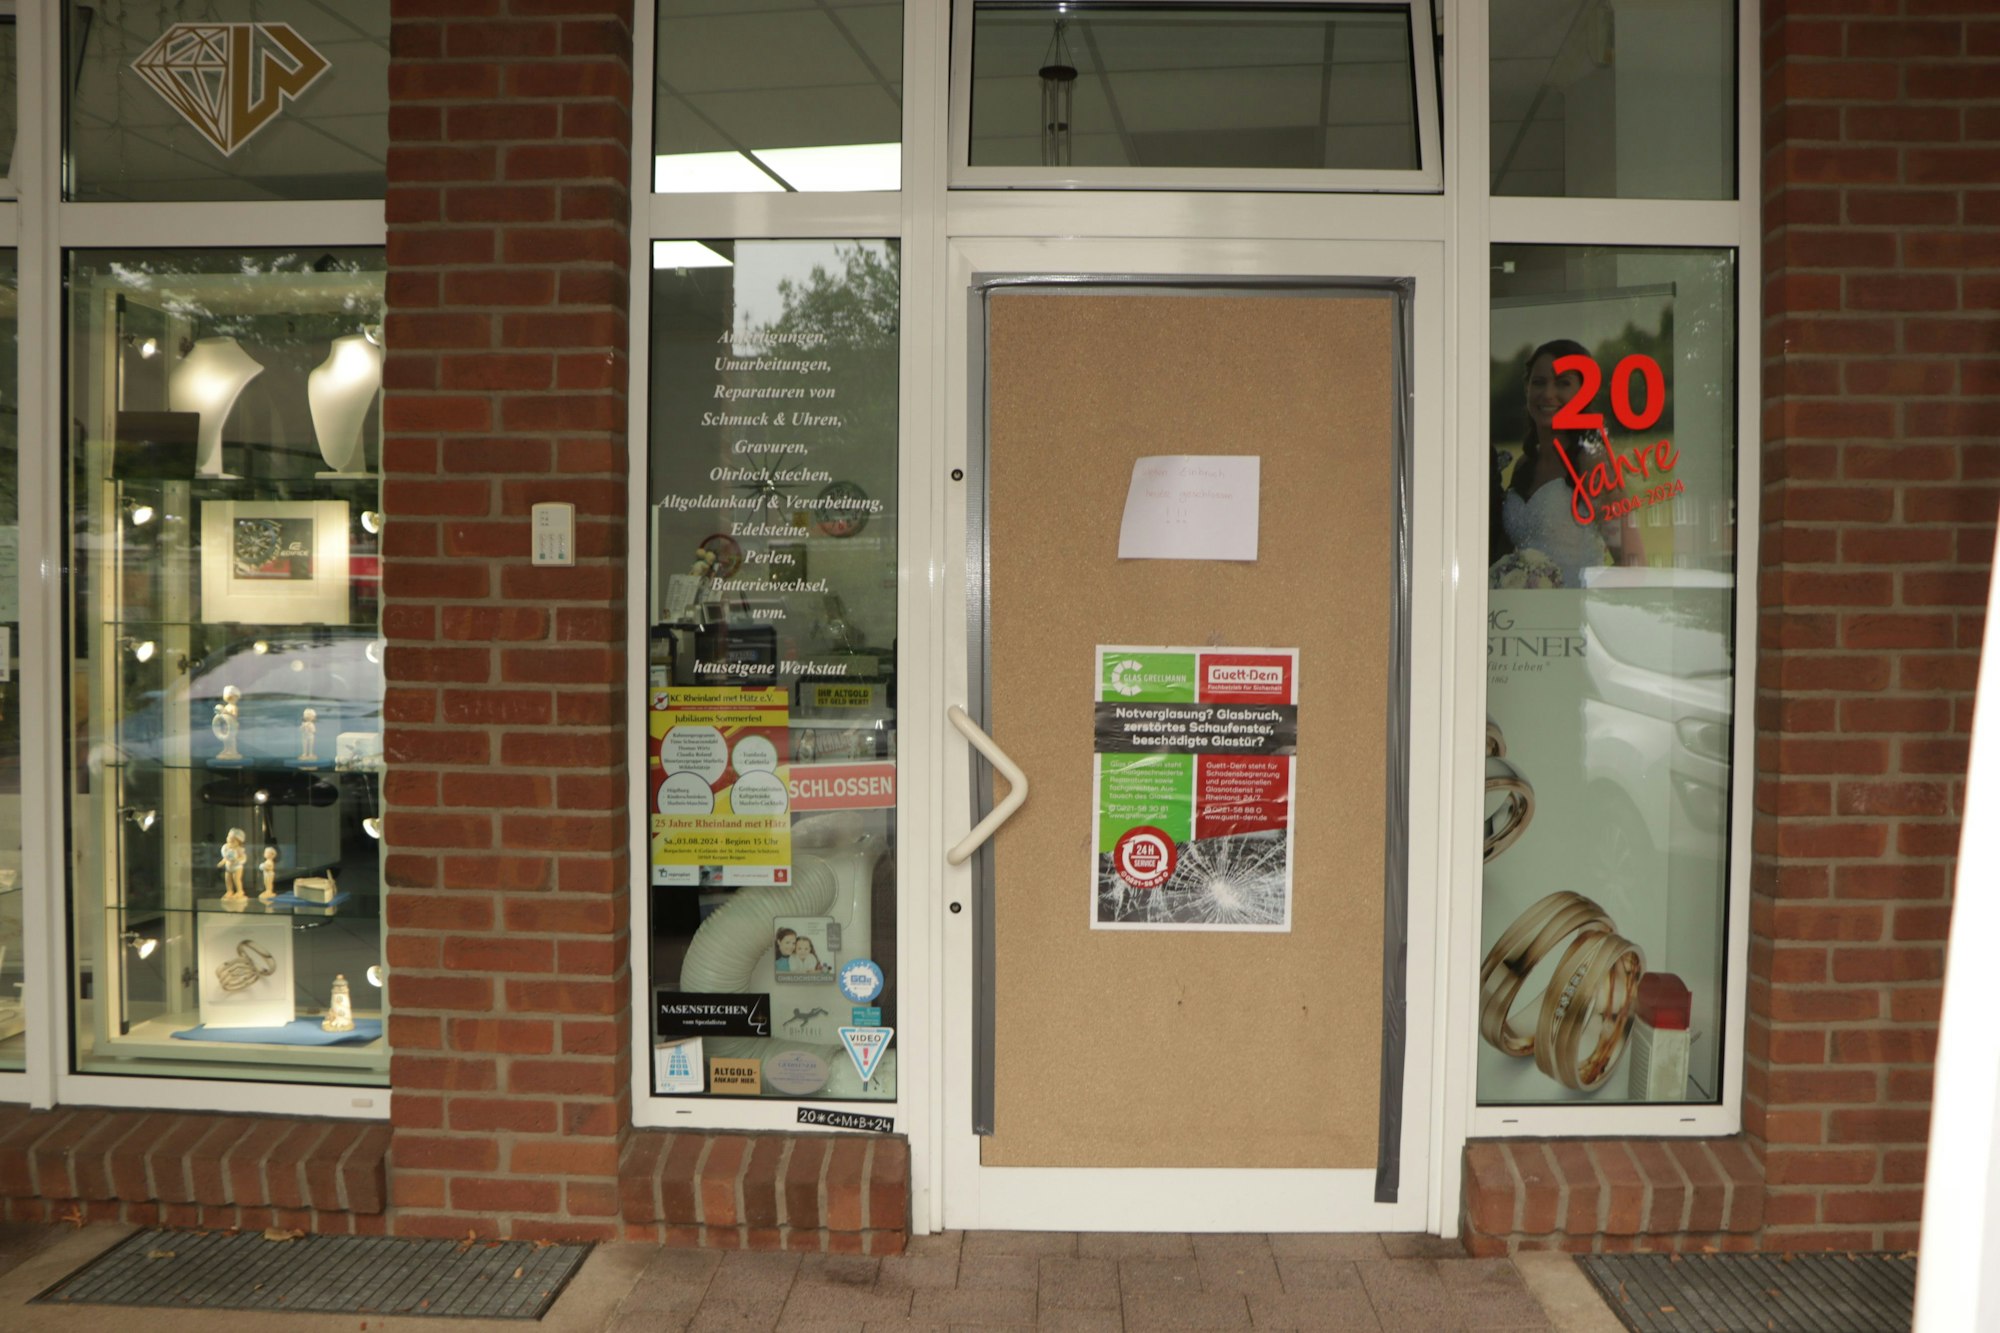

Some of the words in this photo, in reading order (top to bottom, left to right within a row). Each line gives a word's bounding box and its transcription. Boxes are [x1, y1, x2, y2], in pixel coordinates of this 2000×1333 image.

[714, 357, 832, 374] Umarbeitungen,
[713, 384, 805, 401] Reparaturen
[810, 387, 836, 399] von
[1552, 354, 1666, 430] 20
[701, 412, 769, 427] Schmuck
[773, 413, 787, 426] &
[792, 412, 842, 429] Uhren,
[734, 439, 809, 455] Gravuren,
[710, 467, 770, 482] Ohrloch
[774, 468, 833, 483] stechen,
[1553, 427, 1680, 525] Jahre
[658, 494, 765, 512] Altgoldankauf
[767, 496, 780, 508] &
[785, 495, 884, 513] Verarbeitung,
[1601, 478, 1685, 522] 2004-2024
[730, 522, 810, 538] Edelsteine,
[744, 550, 797, 566] Perlen,
[711, 577, 830, 594] Batteriewechsel,
[752, 608, 787, 620] uvm.
[693, 660, 775, 677] hauseigene
[779, 661, 848, 676] Werkstatt
[1123, 674, 1142, 682] GLAS
[1144, 674, 1187, 683] GRELLMANN
[1212, 669, 1279, 682] Guett-Dern
[818, 689, 832, 698] IHR
[834, 689, 869, 698] ALTGOLD
[1253, 684, 1282, 692] Sicherheit
[683, 693, 721, 702] Rheinland
[760, 694, 774, 702] e.V.
[675, 714, 714, 723] Jubiläums
[715, 715, 762, 723] Sommerfest
[1116, 708, 1213, 722] Notverglasung?
[1217, 709, 1283, 723] Glasbruch,
[1123, 721, 1186, 733] zerstörtes
[1189, 722, 1274, 736] Schaufenster,
[1132, 735, 1208, 748] beschädigte
[1211, 735, 1265, 748] Glastür?
[1248, 762, 1267, 770] steht
[1268, 762, 1278, 770] für
[1206, 770, 1280, 779] Schadensbegrenzung
[1221, 778, 1272, 787] professionellen
[1205, 786, 1253, 794] Glasnotdienst
[1255, 786, 1264, 794] im
[655, 819, 666, 828] 25
[668, 819, 693, 828] Jahre
[695, 819, 742, 829] Rheinland
[744, 820, 762, 829] met
[764, 819, 786, 829] Hätz
[1205, 814, 1268, 822] www.guett-dern.de
[725, 838, 751, 847] Beginn
[753, 838, 762, 846] 15
[763, 838, 779, 846] Uhr
[1136, 844, 1147, 856] 24
[1148, 844, 1155, 856] H
[1133, 858, 1156, 868] SERVICE
[661, 1004, 748, 1015] NASENSTECHEN
[695, 1018, 727, 1026] Spezialisten
[850, 1033, 882, 1043] VIDEO
[714, 1067, 757, 1077] ALTGOLD-
[714, 1076, 739, 1084] ANKAUF
[740, 1077, 757, 1085] HIER.
